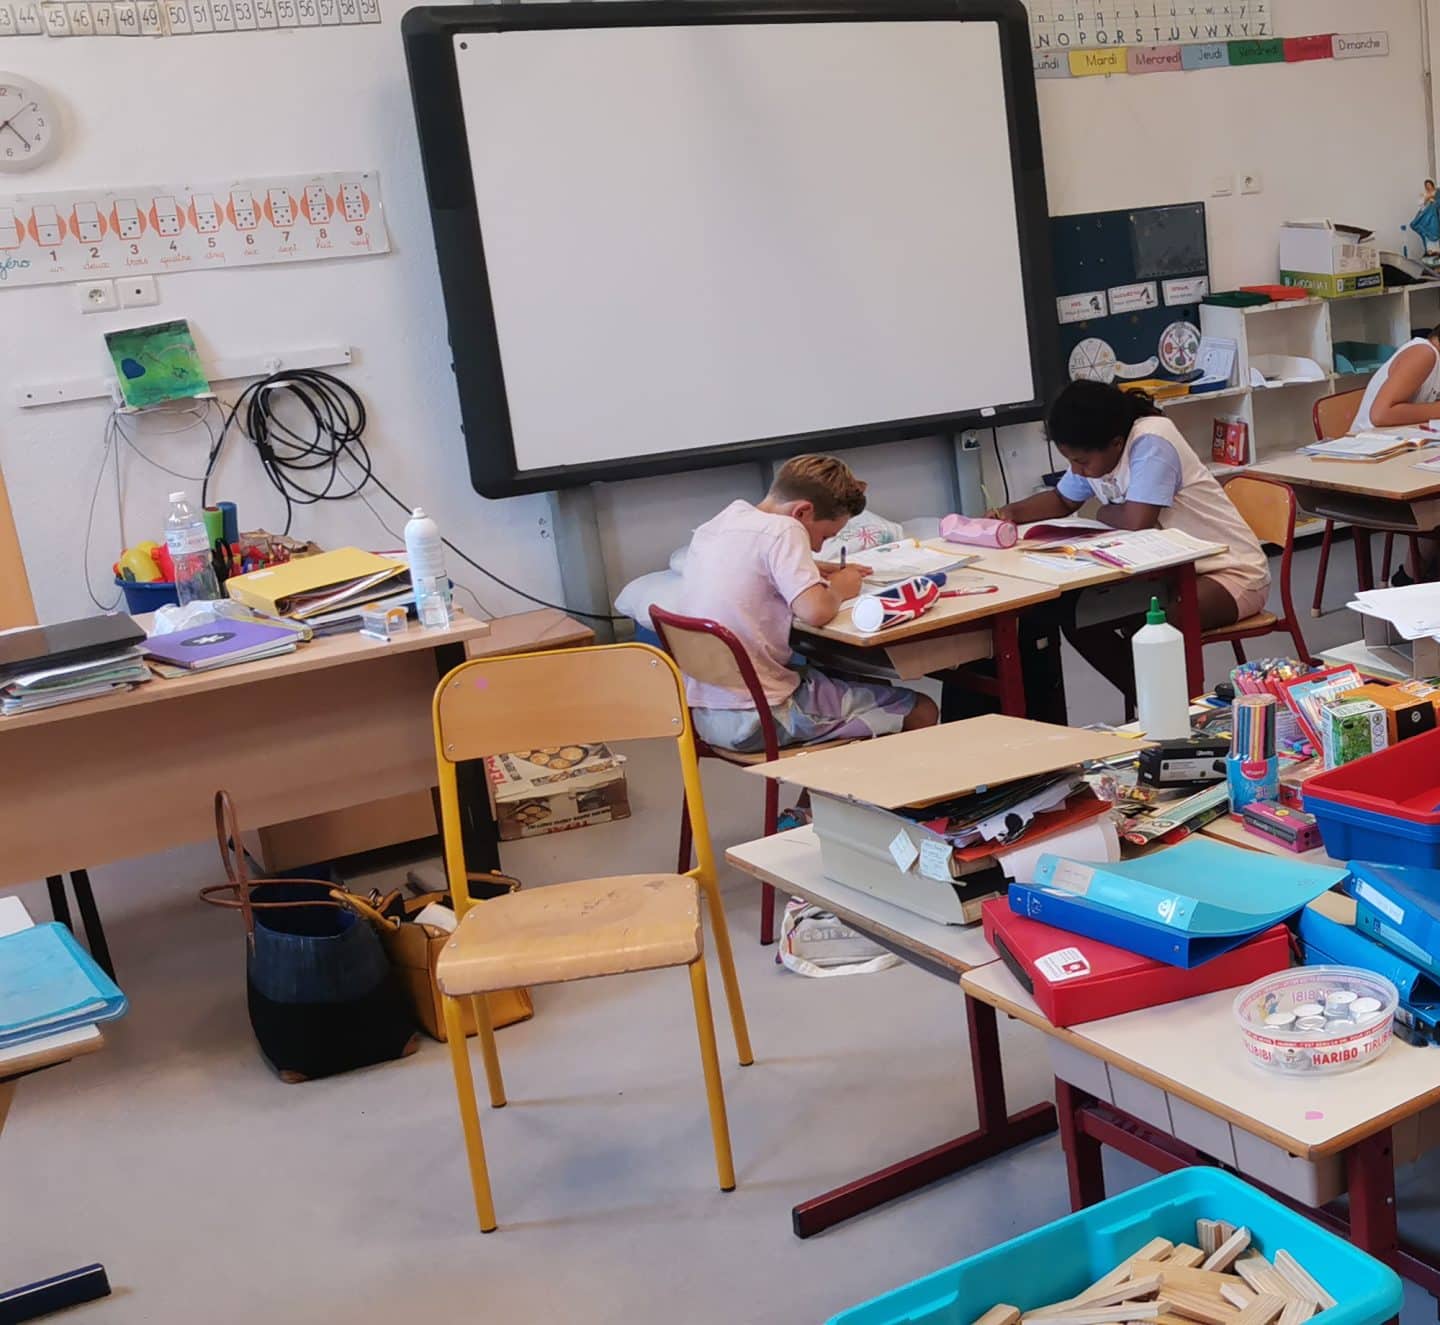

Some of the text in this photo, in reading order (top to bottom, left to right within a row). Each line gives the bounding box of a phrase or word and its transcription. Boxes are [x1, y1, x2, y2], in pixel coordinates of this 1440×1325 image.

[19, 11, 35, 24] 44
[49, 10, 65, 27] 45
[73, 9, 89, 26] 46
[97, 10, 110, 26] 47
[119, 9, 135, 26] 48
[142, 8, 158, 26] 49
[170, 7, 186, 24] 50
[193, 5, 207, 23] 51
[214, 4, 230, 22] 52
[236, 3, 251, 20] 53
[257, 1, 272, 19] 54
[279, 0, 294, 18] 55
[300, 0, 315, 17] 56
[321, 0, 334, 16] 57
[342, 0, 356, 15] 58
[362, 0, 376, 14] 59
[1079, 32, 1087, 45] P
[1096, 30, 1108, 44] Q
[1135, 28, 1144, 42] S
[1153, 27, 1160, 40] T
[1189, 25, 1199, 38] V
[1204, 24, 1217, 38] W
[1224, 23, 1234, 37] X
[1240, 23, 1249, 36] Y
[1258, 22, 1267, 36] Z
[1086, 54, 1118, 67] Mardi
[1135, 53, 1181, 66] Mercredi
[1198, 50, 1223, 62] Jeudi
[1338, 38, 1381, 51] Dimanche
[50, 225, 363, 262] 1 2 3 4 5 6 7 8 9
[1312, 1046, 1358, 1066] HARIBO
